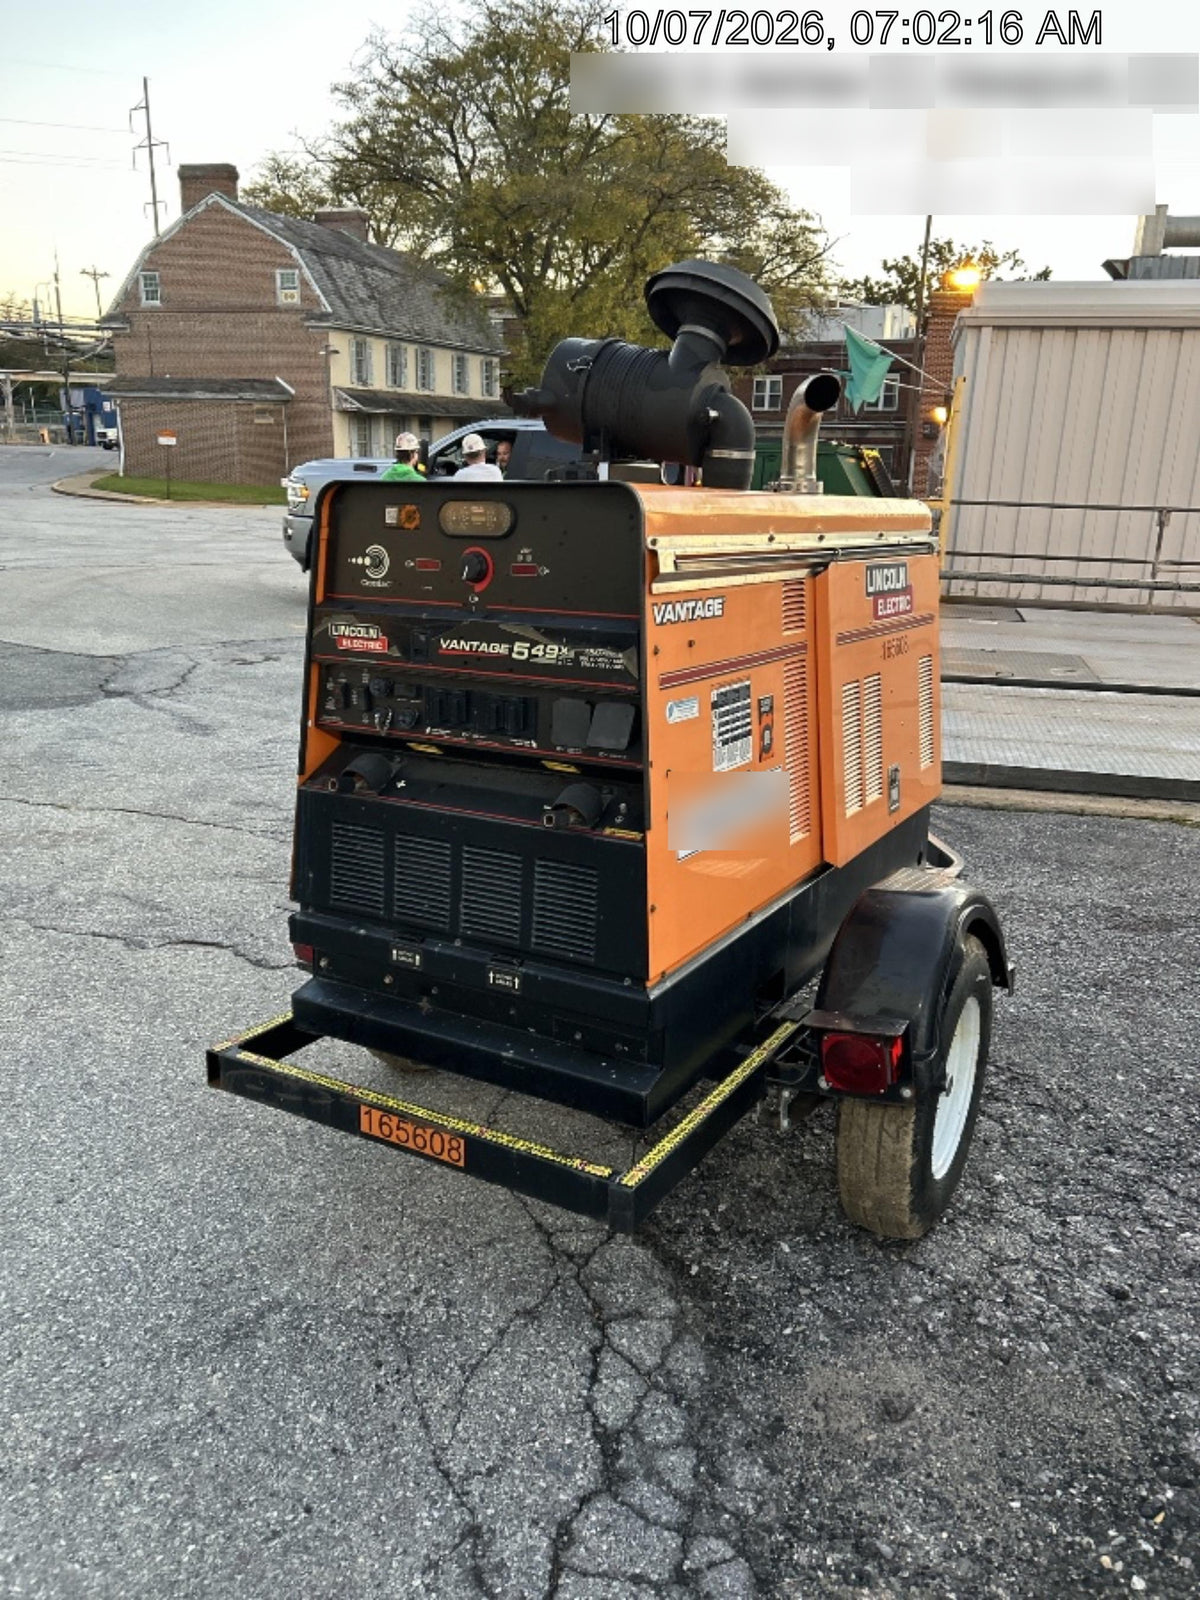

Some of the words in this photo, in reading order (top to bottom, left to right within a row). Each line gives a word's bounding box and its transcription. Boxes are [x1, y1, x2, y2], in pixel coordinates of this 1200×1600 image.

[866, 566, 906, 594] LINCOLN
[652, 597, 724, 625] VANTAGE
[877, 595, 911, 616] ELECTRIC
[331, 624, 379, 639] LINCOLN
[341, 637, 383, 650] ELECTRIC
[439, 637, 510, 655] VANTAGE
[363, 1108, 462, 1164] 165608
